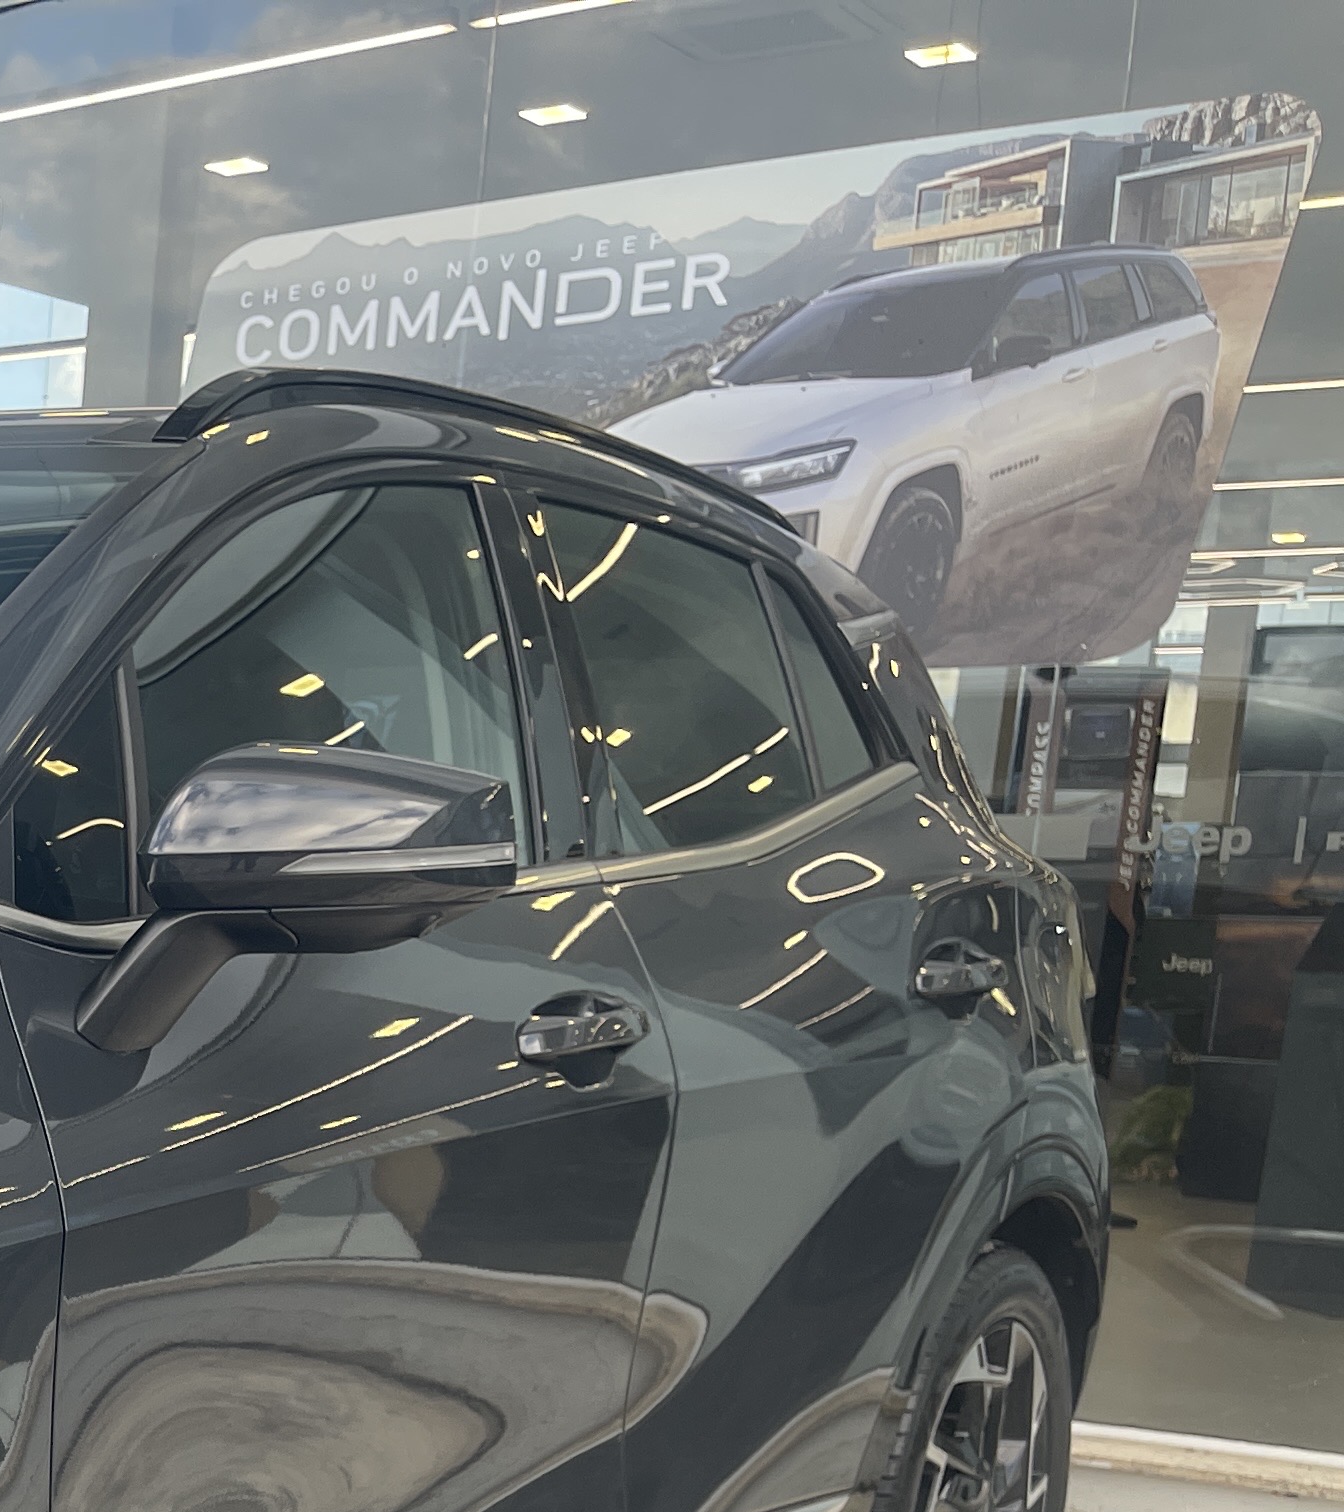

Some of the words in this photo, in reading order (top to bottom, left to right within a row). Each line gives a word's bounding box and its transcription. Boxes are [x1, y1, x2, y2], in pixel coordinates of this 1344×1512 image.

[235, 251, 731, 367] COMMANDER
[239, 274, 377, 309] CHEGOU
[403, 266, 420, 284] O
[446, 248, 542, 280] NOVO
[570, 231, 668, 263] JEEP
[1025, 721, 1051, 817] OMPASS
[1125, 699, 1156, 834] COMMANDER
[1125, 813, 1253, 863] Jeep
[1161, 952, 1213, 977] Jeep
